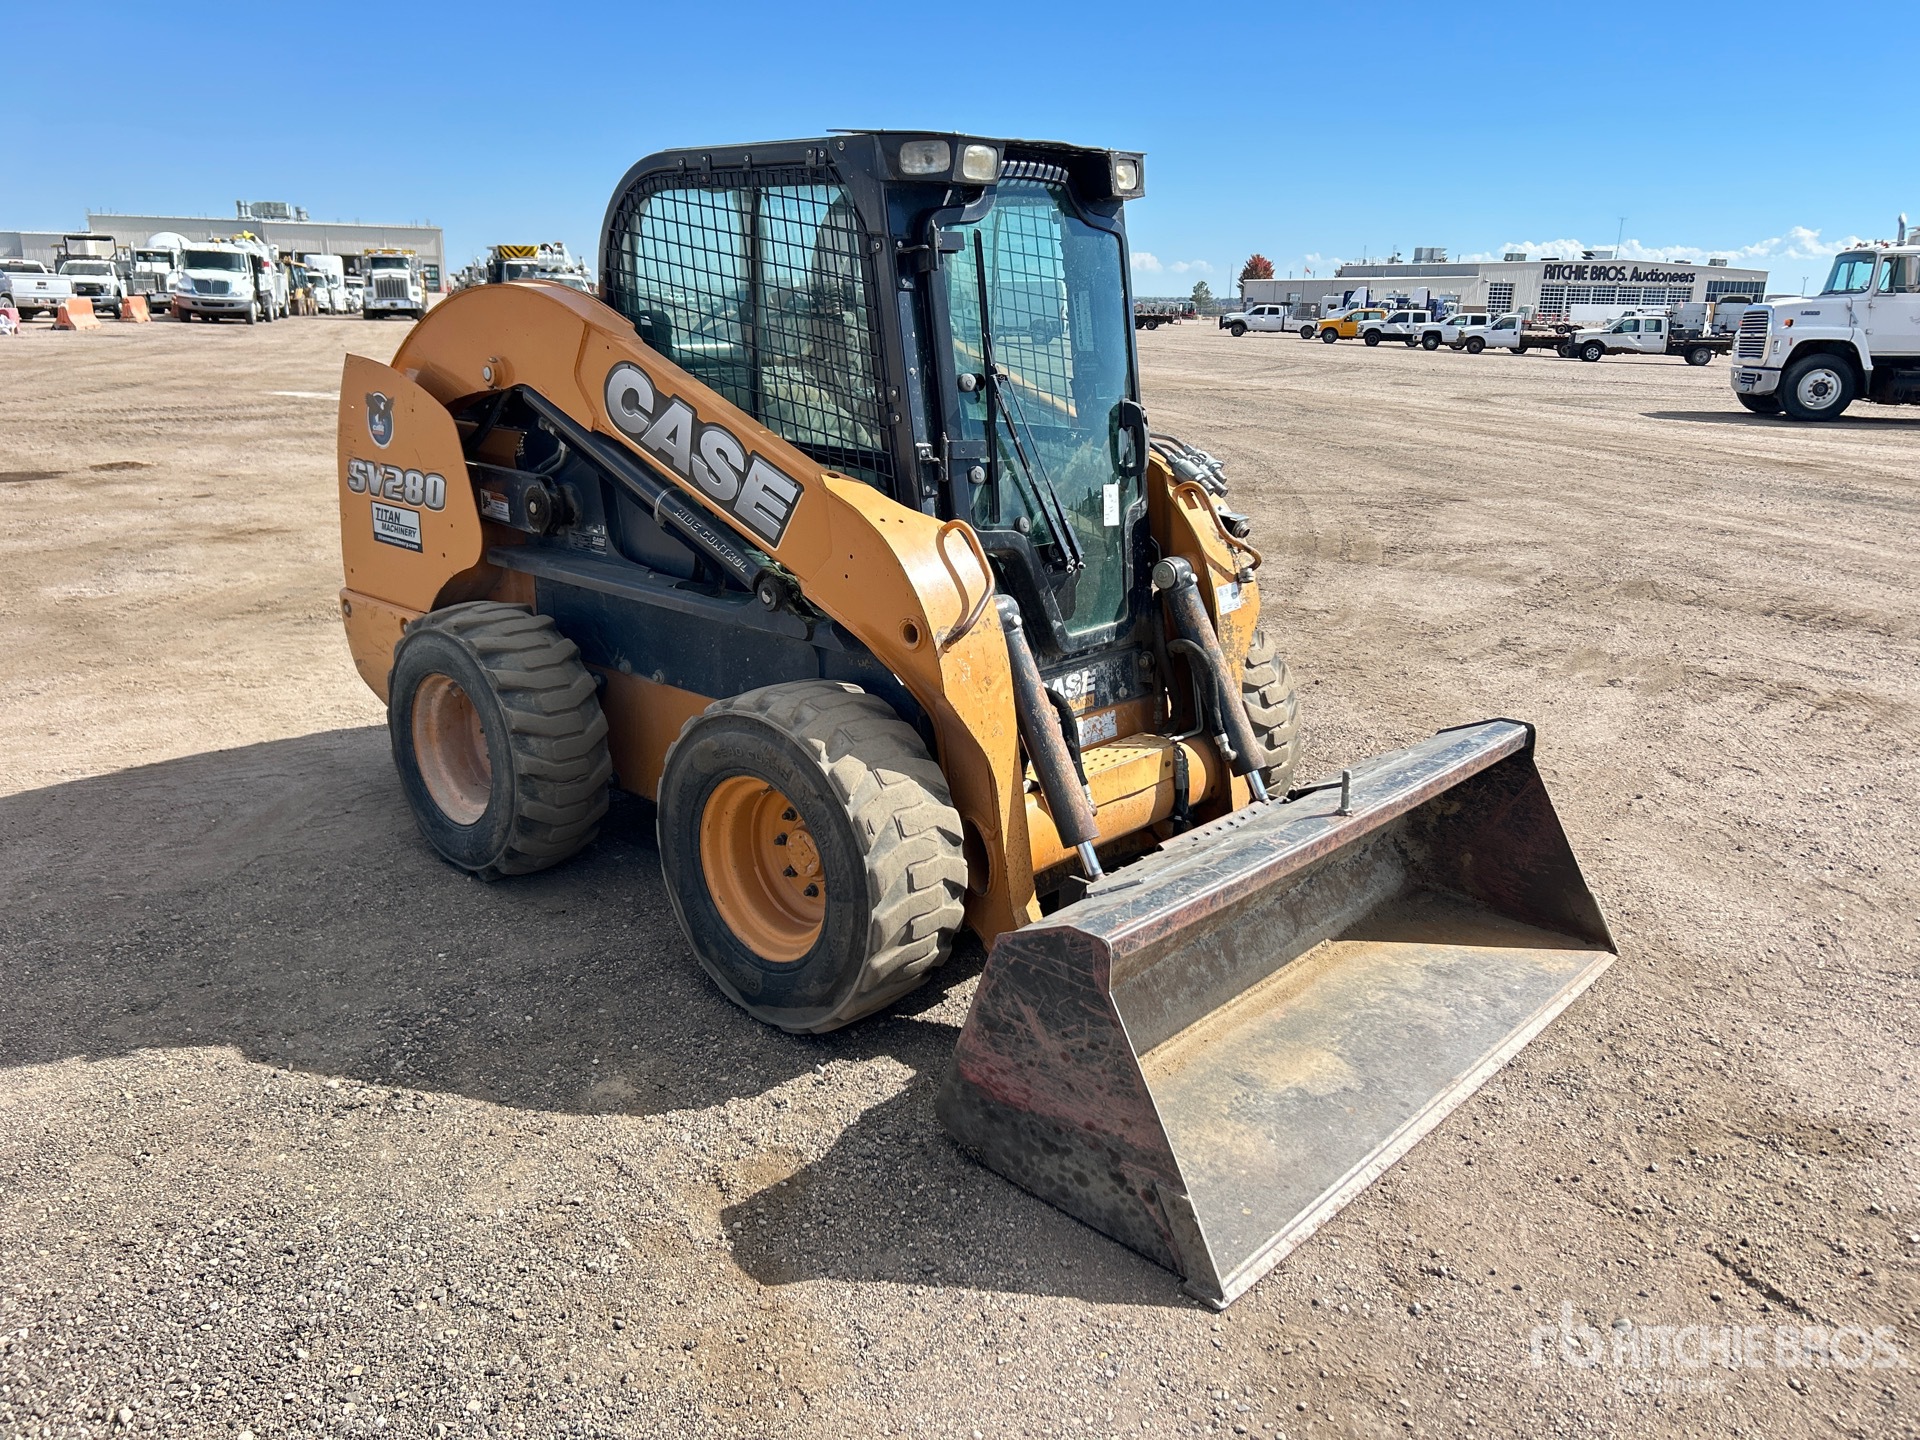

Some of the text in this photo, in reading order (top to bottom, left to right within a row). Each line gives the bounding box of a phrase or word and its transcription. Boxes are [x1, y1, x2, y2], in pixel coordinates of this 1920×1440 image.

[1543, 264, 1696, 283] RITCHIE BROS. Auctioneers
[606, 364, 800, 543] CASE
[347, 457, 447, 512] SV280
[375, 507, 401, 523] TITAN
[381, 522, 417, 538] MACHINERY
[674, 509, 748, 573] RIDE CONTROL
[1043, 668, 1097, 699] ASE
